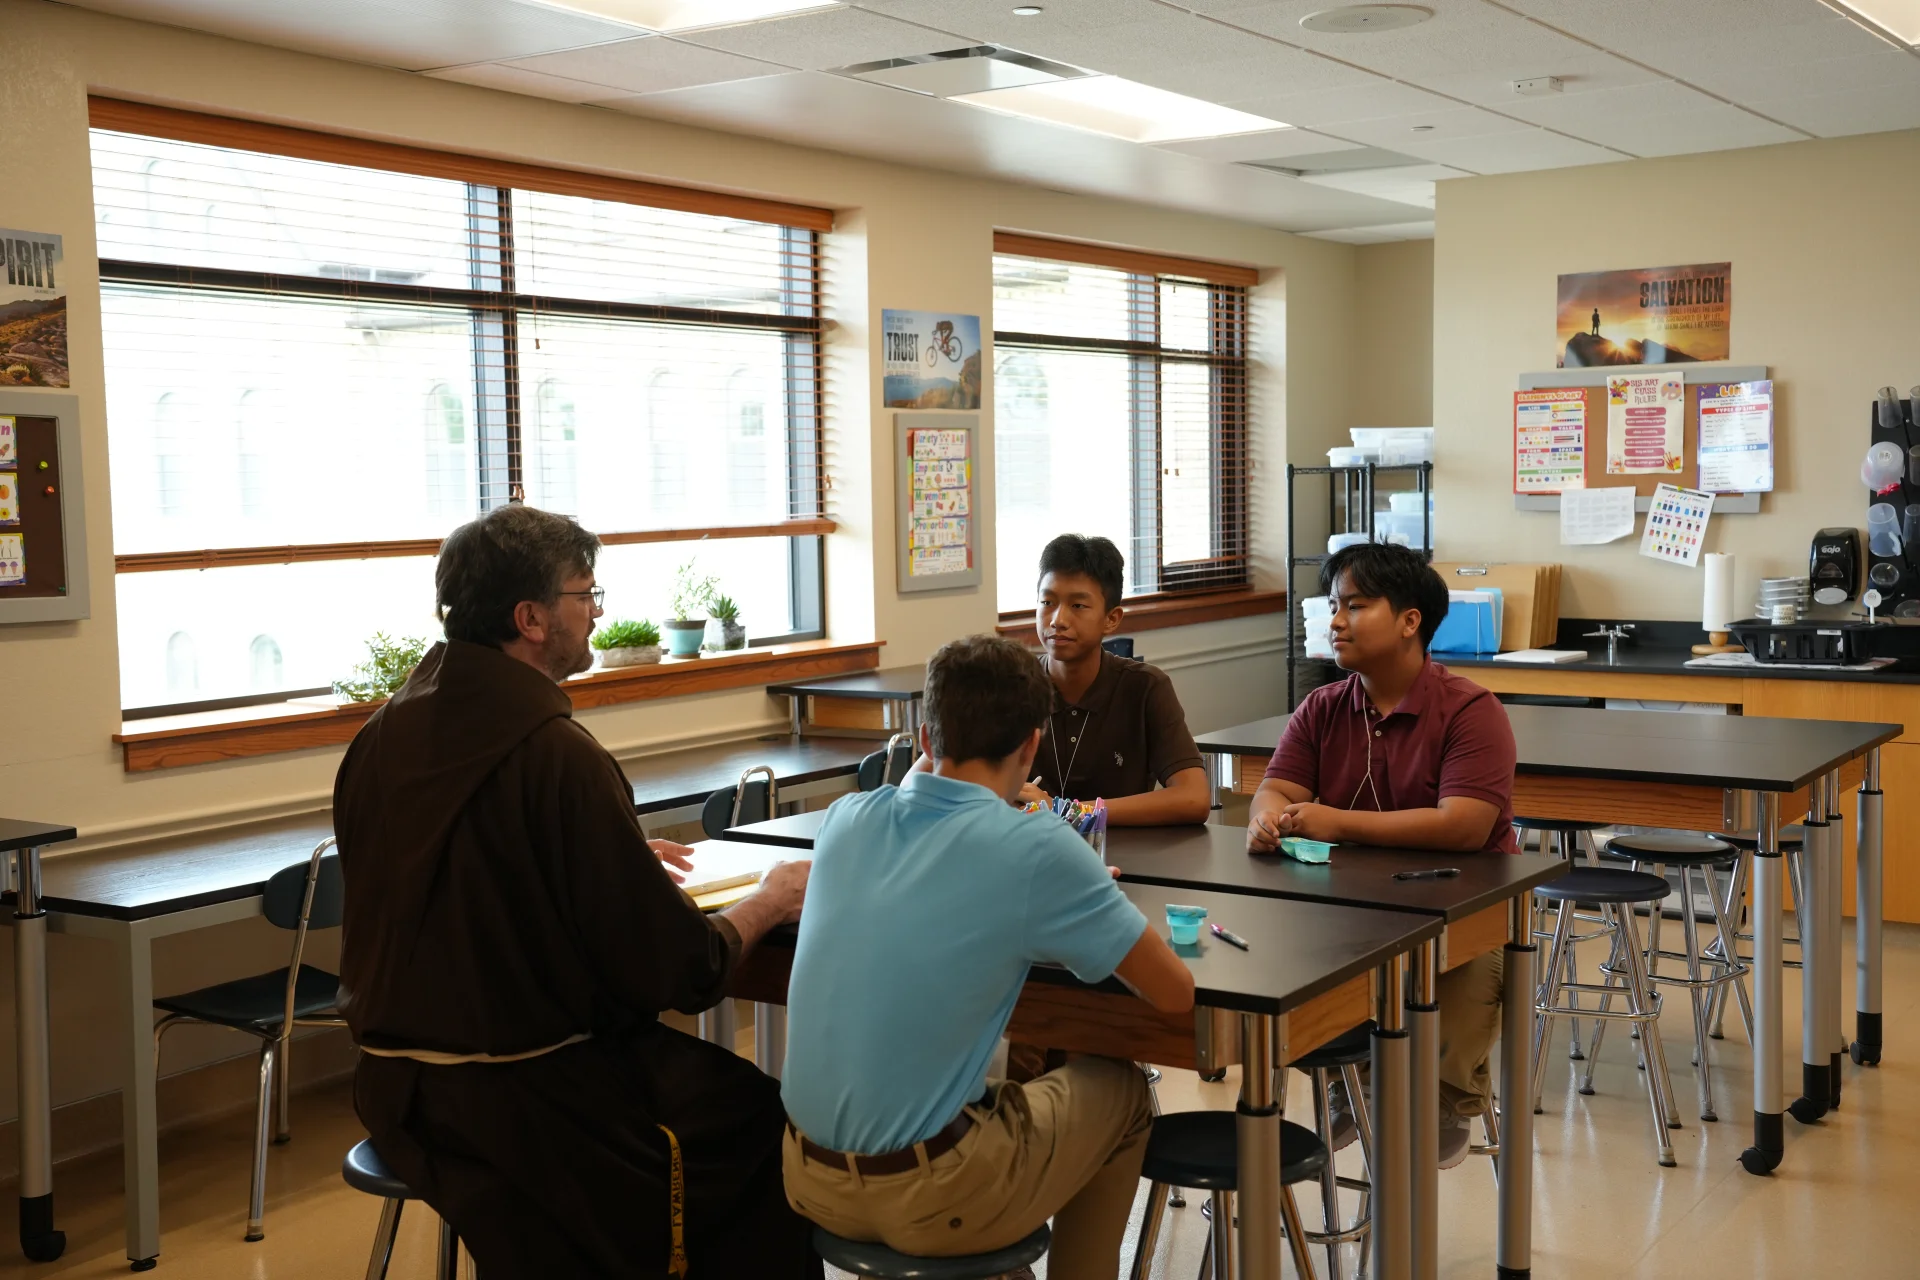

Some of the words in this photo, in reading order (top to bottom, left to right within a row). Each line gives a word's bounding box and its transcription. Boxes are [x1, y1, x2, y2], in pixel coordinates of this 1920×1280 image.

[1640, 277, 1724, 308] SALVATION
[886, 332, 919, 362] TRUST
[1644, 378, 1660, 386] ART
[1634, 387, 1657, 396] CLASS
[1634, 395, 1657, 405] RULES
[915, 432, 938, 446] Variety
[915, 462, 943, 474] Emphasis
[915, 491, 950, 501] Movement
[915, 519, 954, 531] Proportion
[914, 549, 941, 559] Pattern
